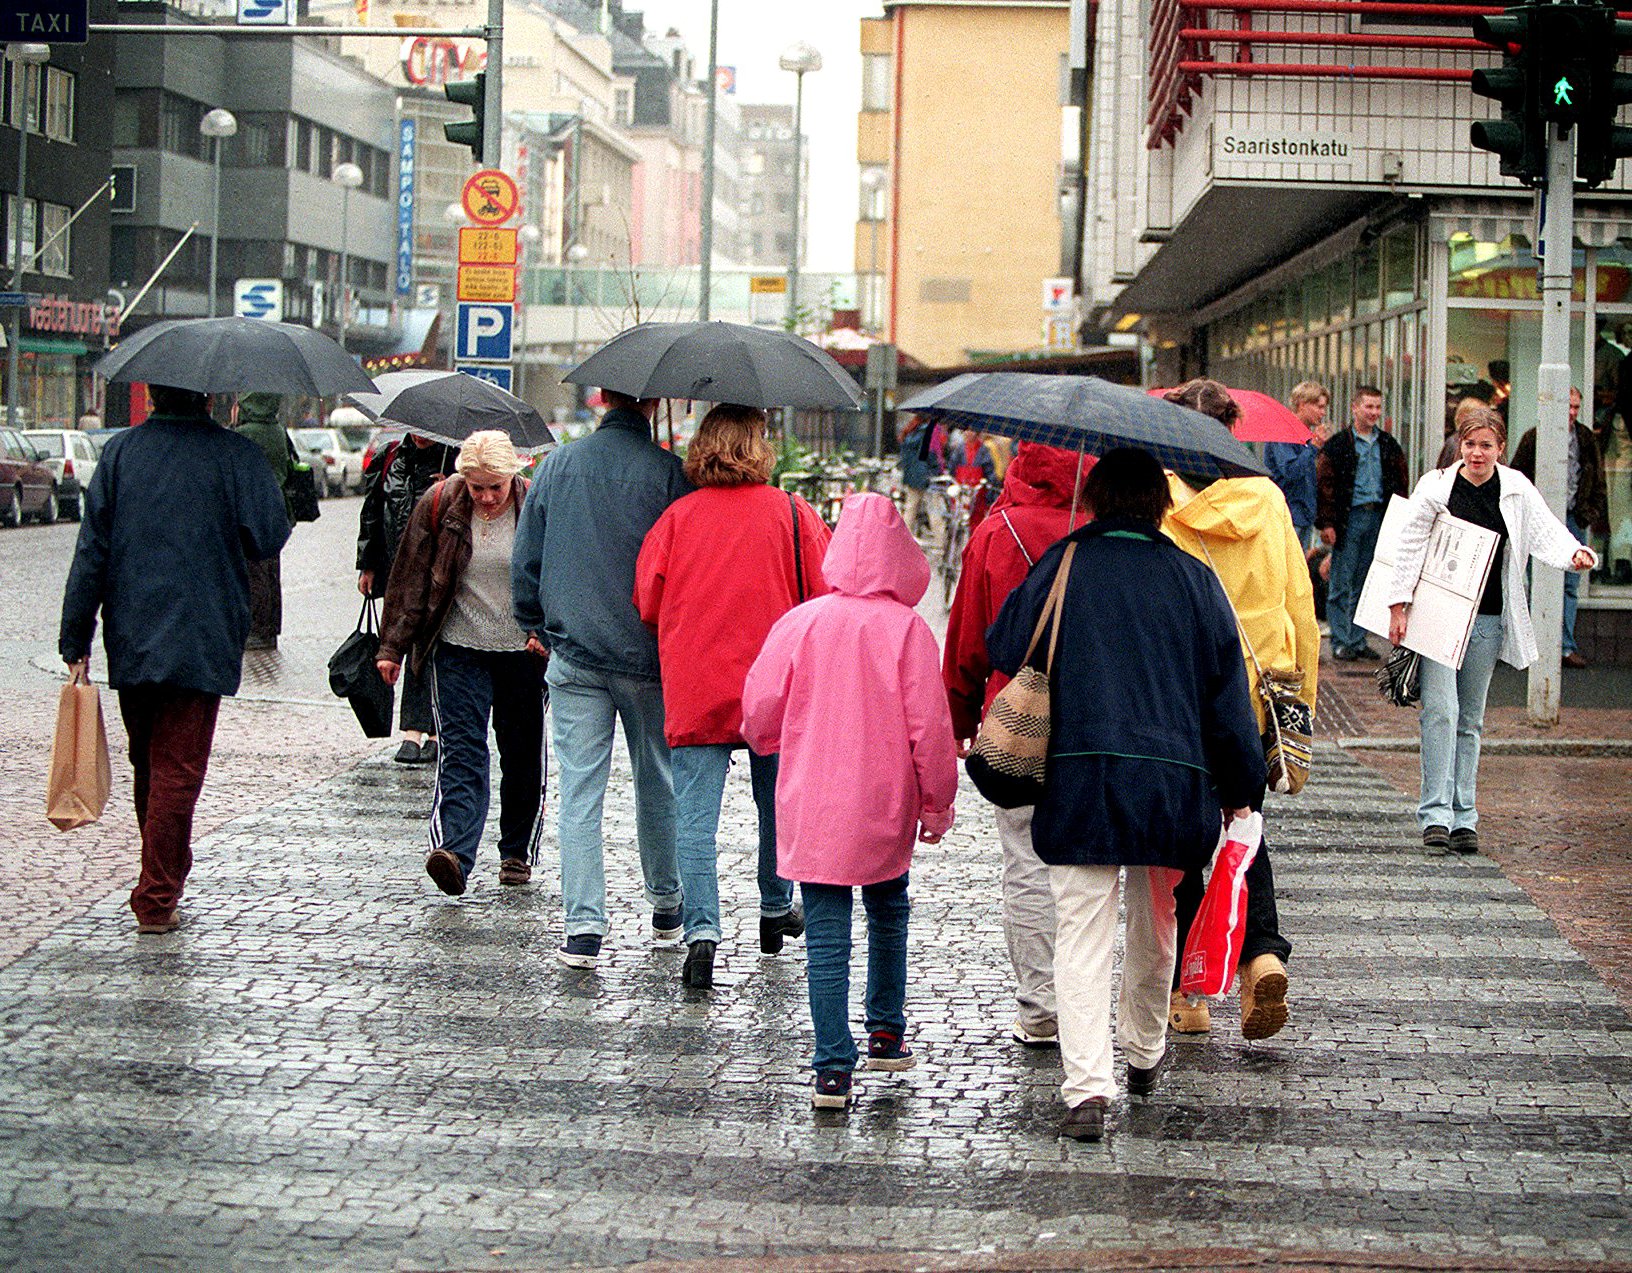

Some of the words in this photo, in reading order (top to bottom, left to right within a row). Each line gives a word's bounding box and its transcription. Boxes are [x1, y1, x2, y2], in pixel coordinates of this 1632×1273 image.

[15, 13, 70, 33] TAXI
[1223, 136, 1348, 157] Saaristonkatu
[466, 307, 505, 357] P
